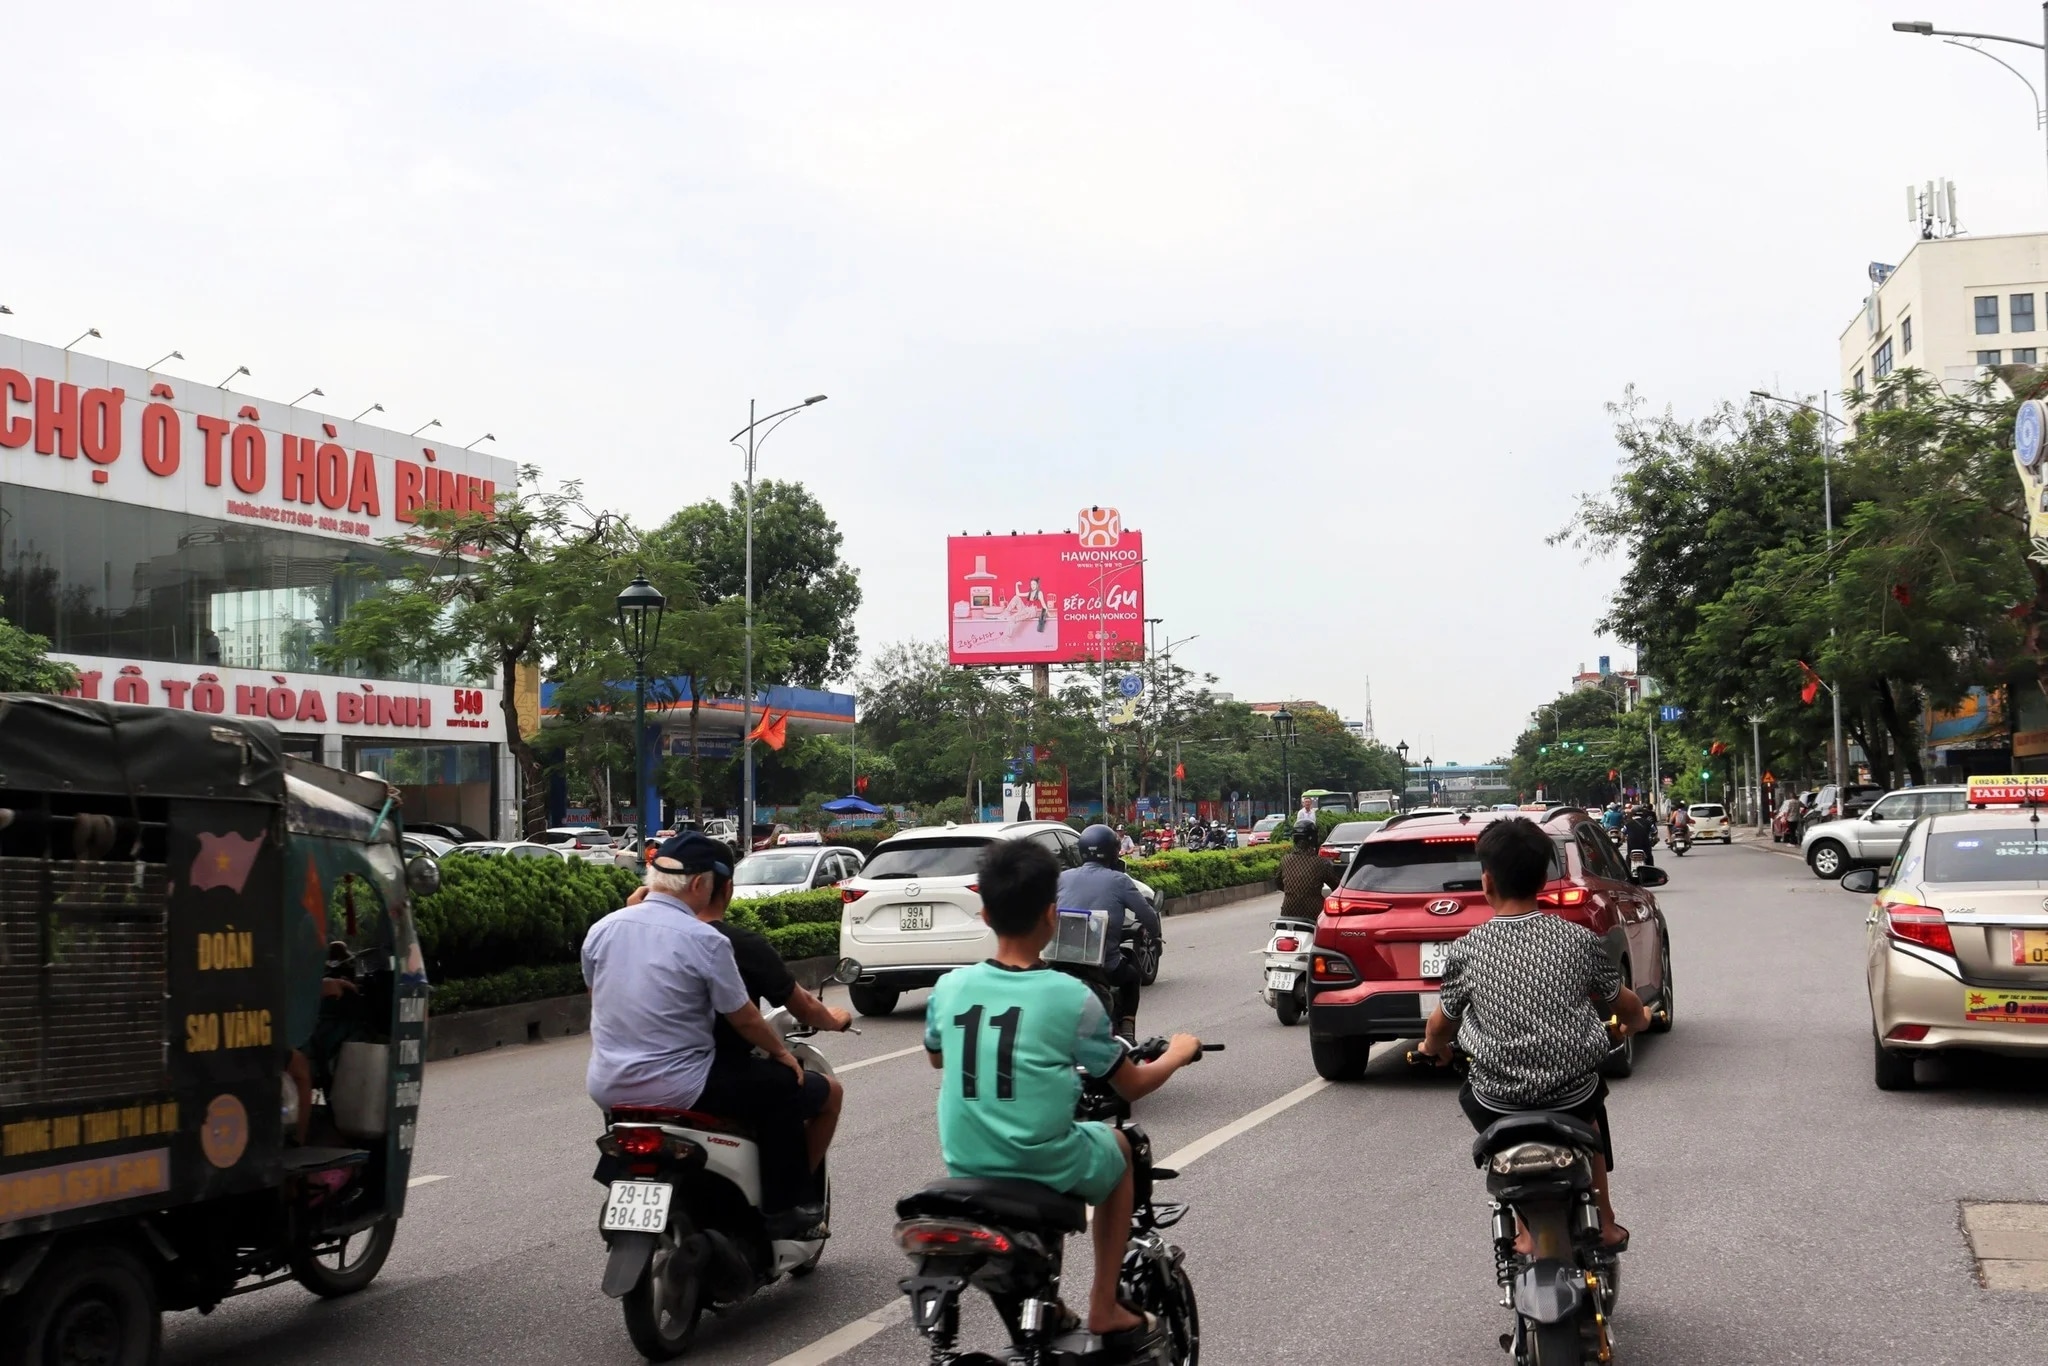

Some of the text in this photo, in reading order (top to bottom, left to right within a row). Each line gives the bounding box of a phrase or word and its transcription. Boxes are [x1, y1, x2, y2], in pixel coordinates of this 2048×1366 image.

[0, 367, 496, 532] CHỢ Ô TÔ HÒA BÌNH
[1061, 550, 1138, 561] HAWONKOO
[1063, 593, 1086, 611] BẾP
[1063, 612, 1138, 622] CHỌN HAWONKOO
[160, 673, 225, 714] TÔ
[235, 676, 328, 722] HÒA
[337, 684, 432, 728] BÌNH
[454, 689, 483, 715] 549
[1974, 788, 2045, 798] TAXI LONG
[907, 907, 924, 918] 99A
[1947, 906, 1977, 914] VIOS
[901, 918, 930, 929] 328.14
[953, 1004, 1023, 1101] 11
[707, 1136, 740, 1148] VISION
[616, 1185, 662, 1206] 29-L5
[607, 1207, 663, 1228] 384.85
